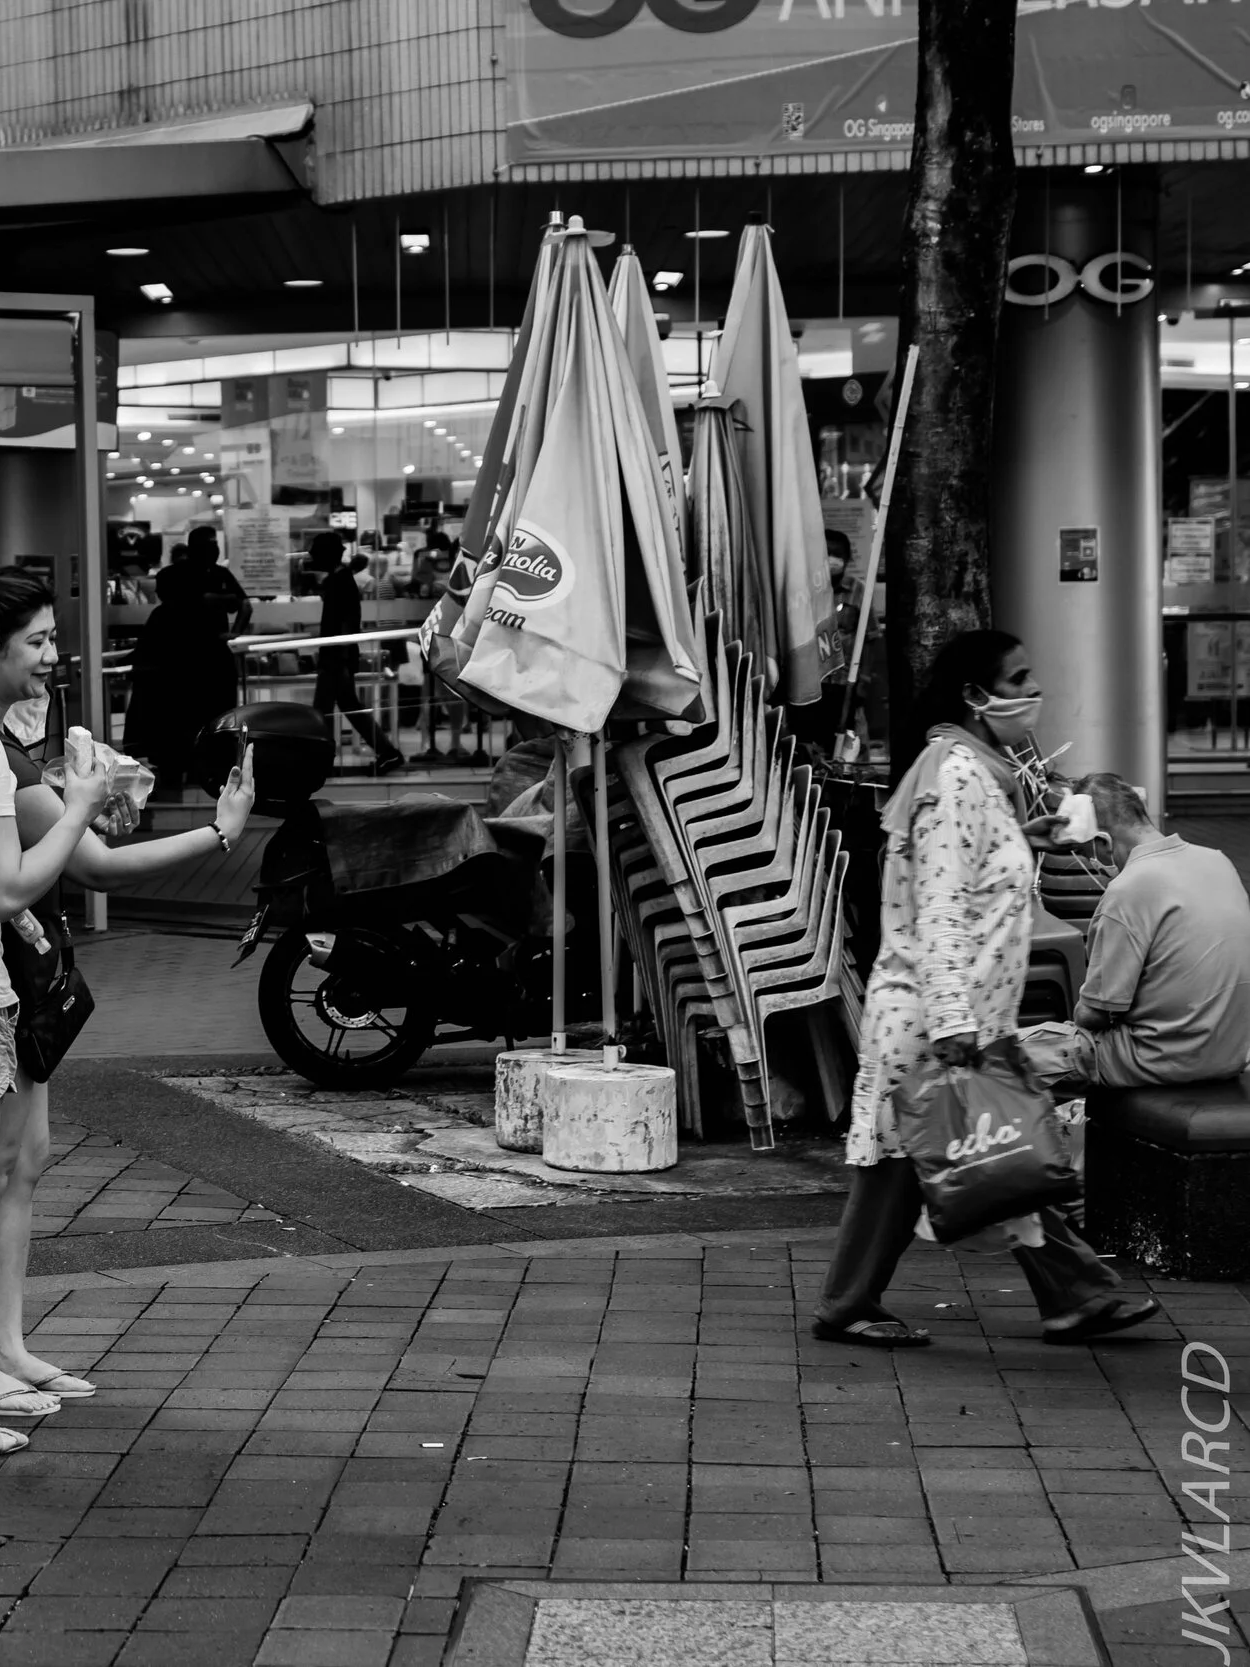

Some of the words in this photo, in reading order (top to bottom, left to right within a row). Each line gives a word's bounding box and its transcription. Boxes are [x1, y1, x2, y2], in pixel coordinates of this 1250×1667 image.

[843, 119, 866, 137] OG
[868, 118, 915, 141] Singapor
[1090, 110, 1171, 133] ogsingapore
[1217, 110, 1250, 130] og.co
[1004, 252, 1154, 306] OG
[503, 552, 557, 581] nolia
[484, 606, 526, 630] eam
